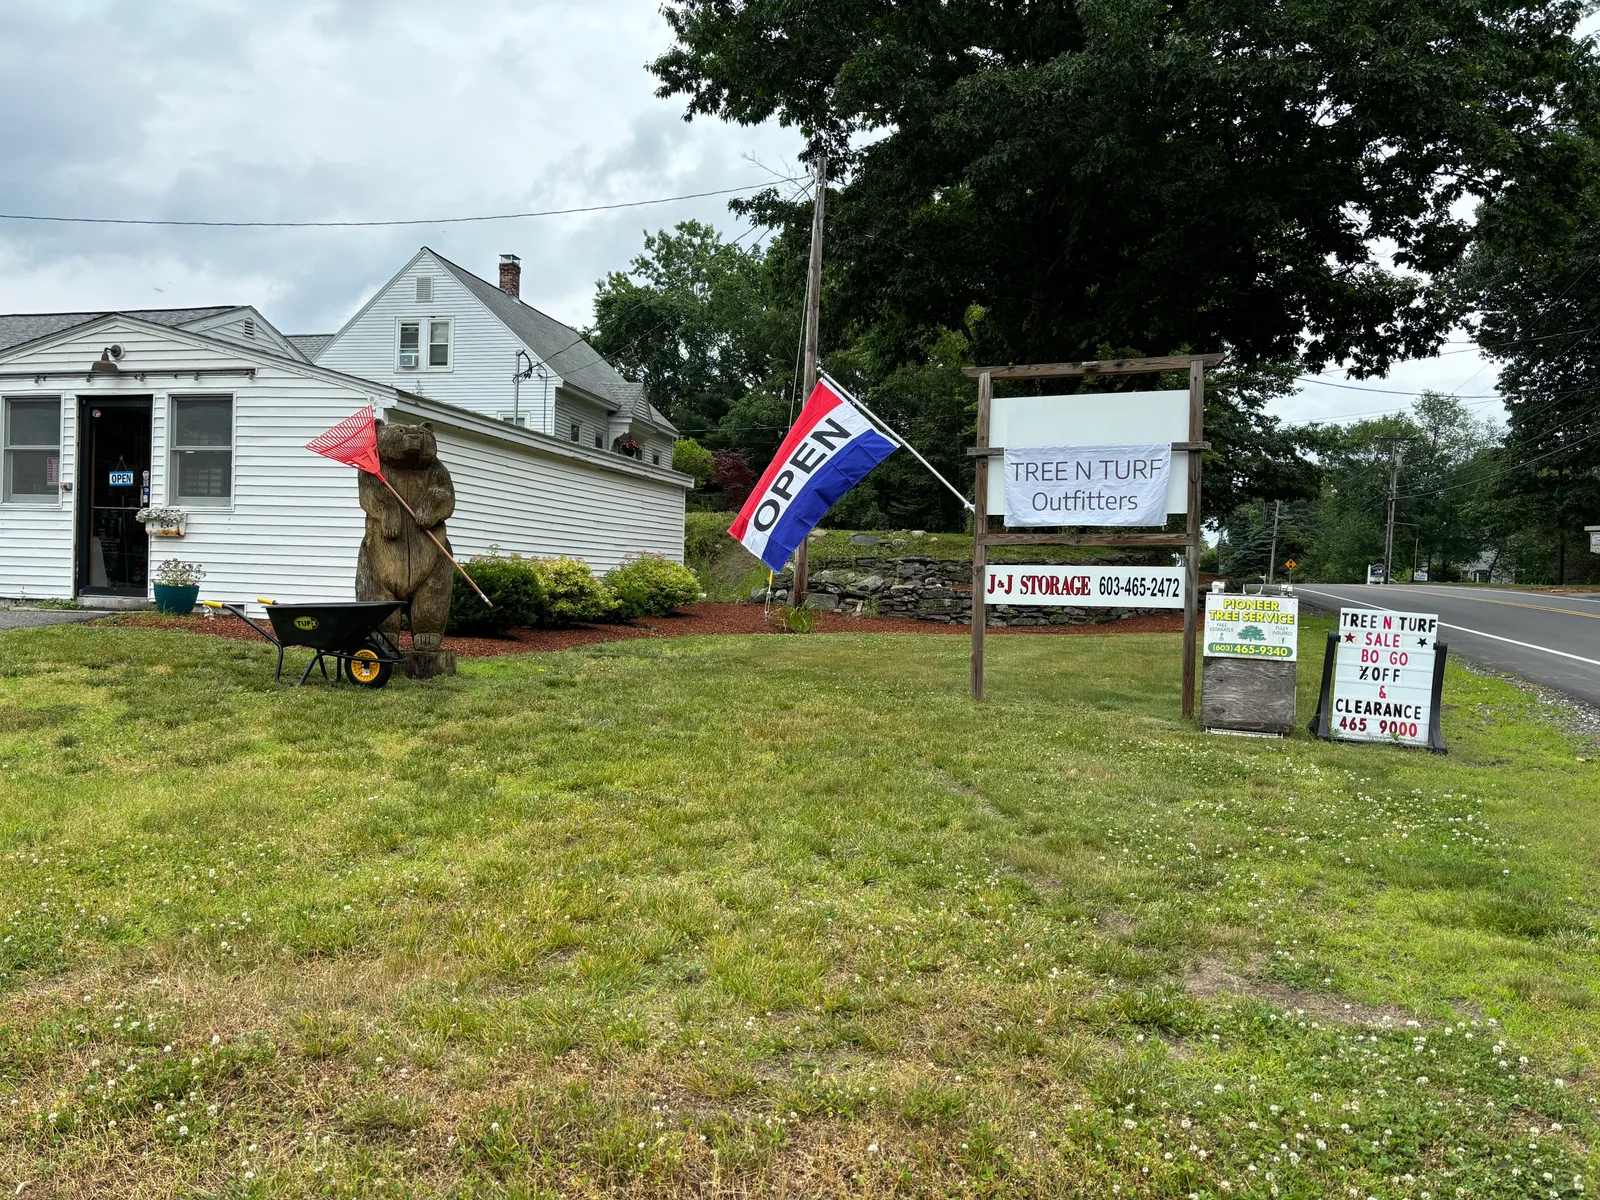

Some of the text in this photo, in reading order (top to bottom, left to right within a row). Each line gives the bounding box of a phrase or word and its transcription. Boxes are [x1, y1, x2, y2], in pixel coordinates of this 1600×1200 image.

[111, 474, 132, 483] OPEN
[753, 417, 852, 532] OPEN
[1010, 458, 1163, 482] TREE N TURF
[1032, 489, 1138, 511] Outfitters
[987, 574, 1180, 598] J&J STORAGE 603-465-2472
[1223, 599, 1280, 612] PIONEER
[1209, 610, 1295, 624] TREE SERVICE
[1342, 613, 1437, 633] TREE N TURF
[1365, 632, 1401, 648] SALE
[1212, 643, 1288, 657] (603) 465-9340
[1361, 648, 1409, 667] BO GO
[1378, 685, 1387, 699] &
[1335, 698, 1422, 720] CLEARANCE
[1339, 716, 1418, 738] 465 9000
